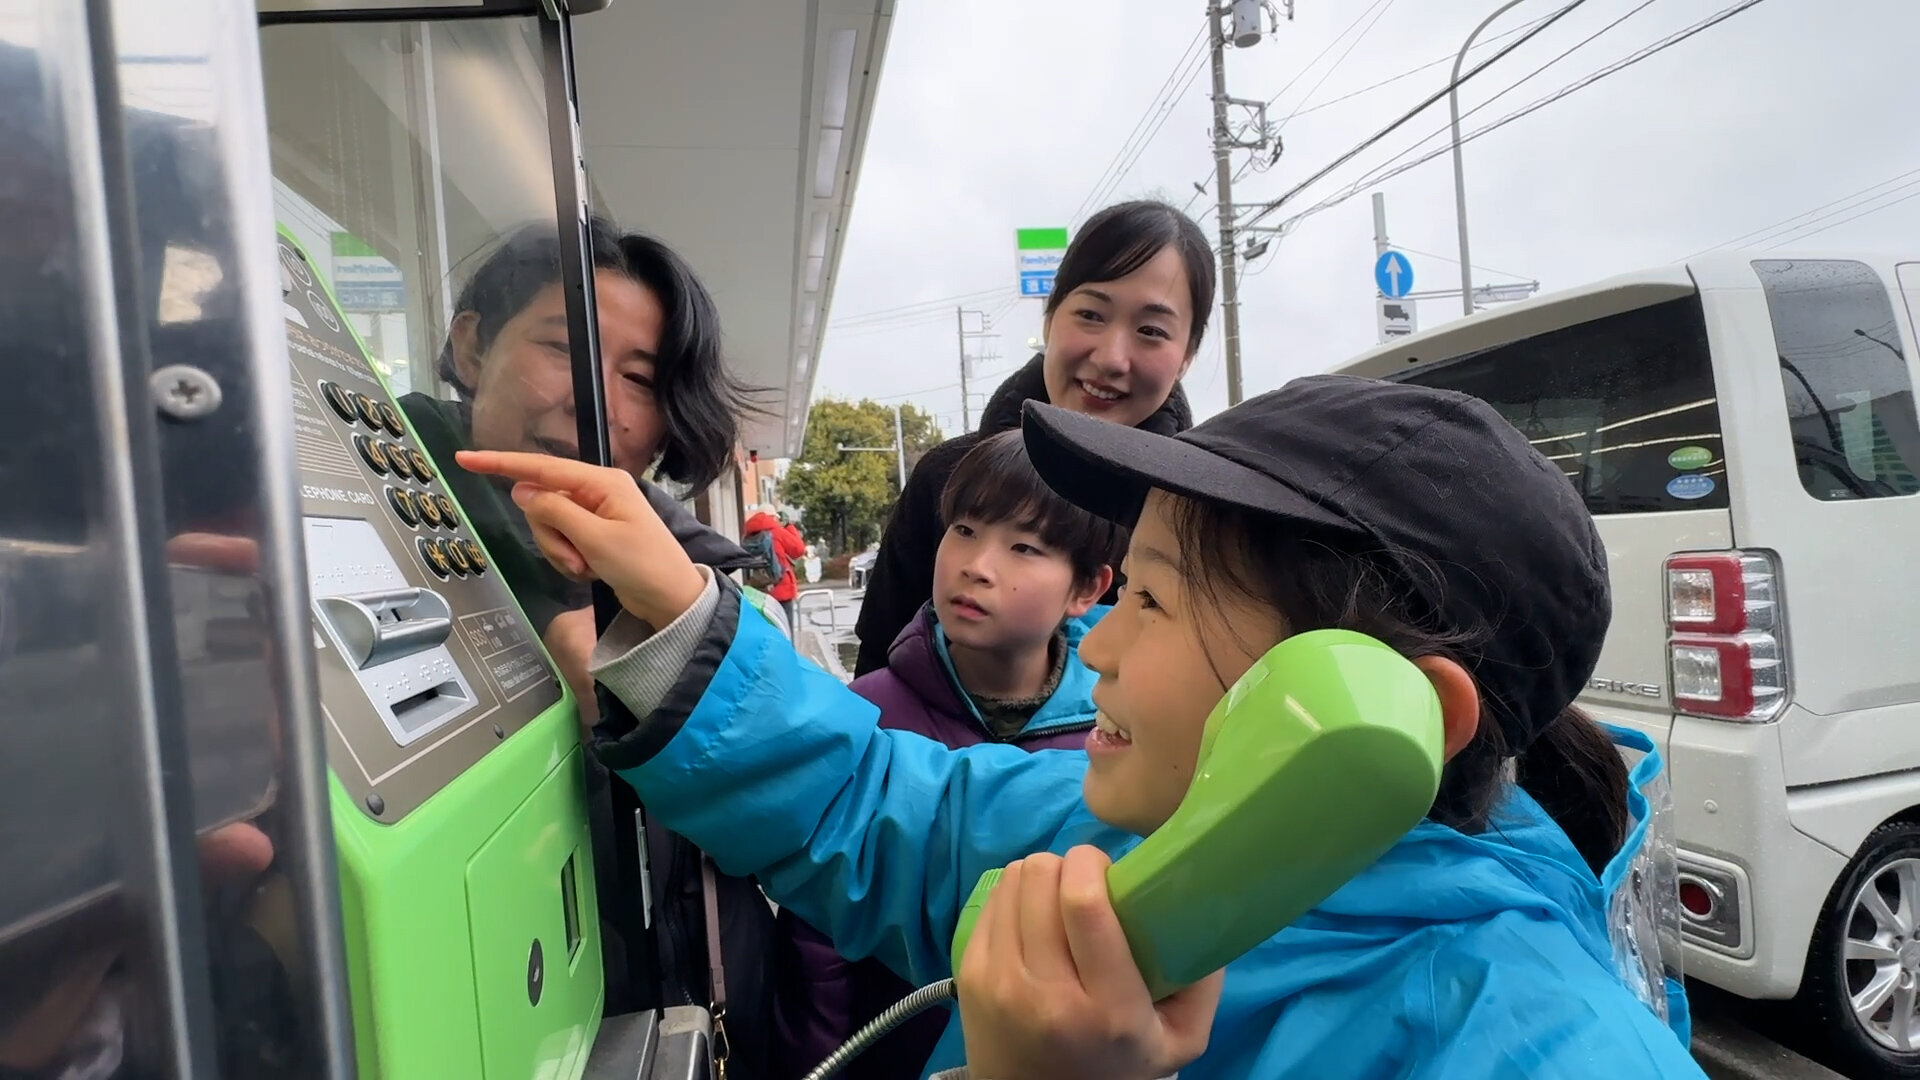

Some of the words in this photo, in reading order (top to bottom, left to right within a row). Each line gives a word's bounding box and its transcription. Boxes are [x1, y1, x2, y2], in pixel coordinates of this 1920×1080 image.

[389, 445, 411, 473] 5
[412, 452, 432, 478] 6
[347, 490, 375, 505] CARD
[397, 491, 416, 519] 7
[420, 494, 441, 521] 8
[449, 541, 469, 568] 0
